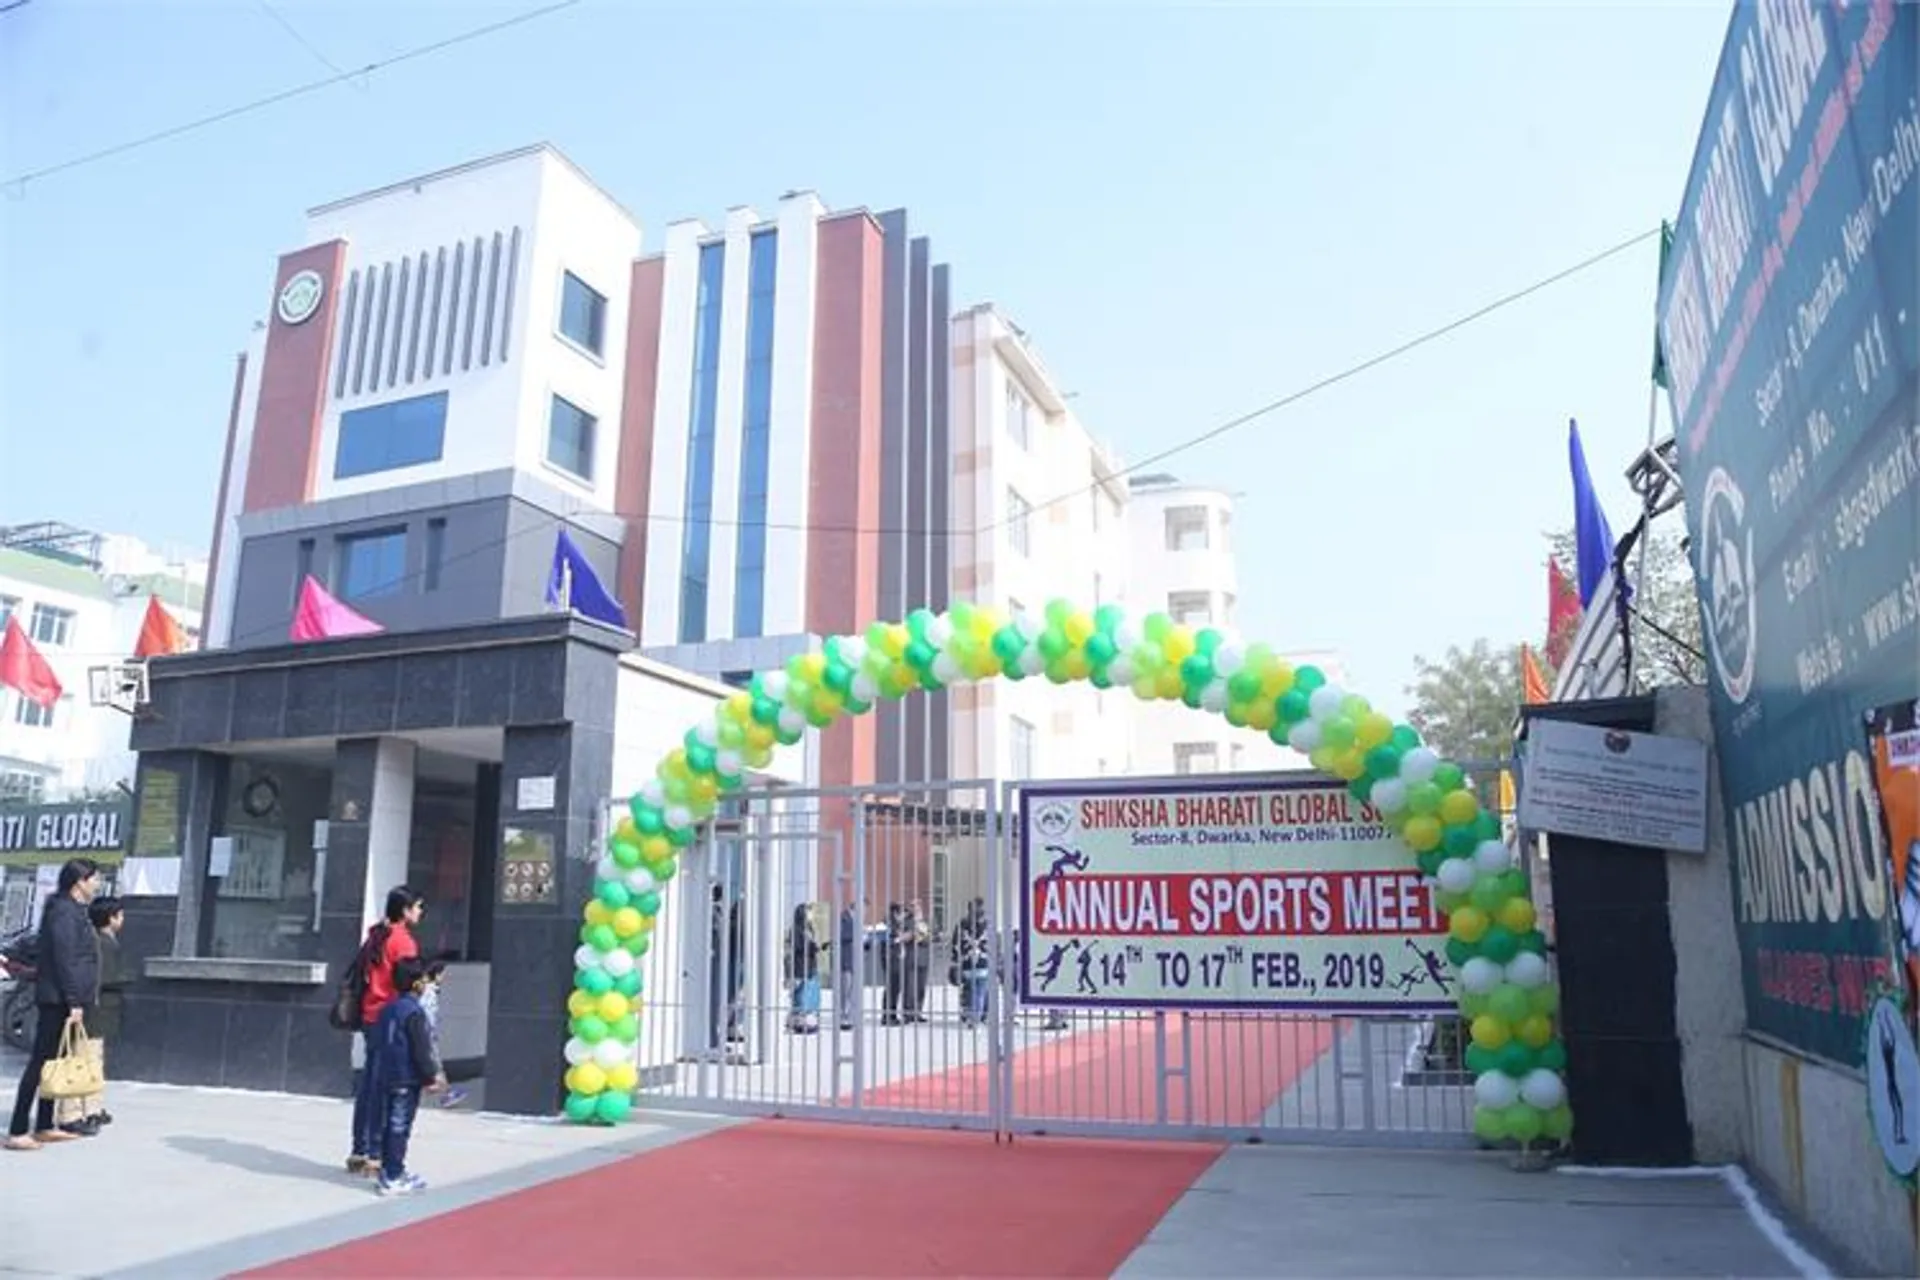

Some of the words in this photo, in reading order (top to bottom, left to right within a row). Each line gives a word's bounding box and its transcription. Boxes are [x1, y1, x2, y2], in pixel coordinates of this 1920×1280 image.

[0, 814, 24, 849] TI
[36, 811, 119, 849] GLOBAL
[1081, 798, 1169, 830] SHIKSHA
[1175, 795, 1263, 827] BHARATI
[1270, 792, 1353, 825] GLOBAL
[1198, 826, 1256, 845] Dwarka,
[1260, 826, 1297, 843] New
[1733, 749, 1891, 923] ADMISSIO
[1041, 879, 1179, 931] ANNUAL
[1189, 876, 1332, 932] SPORTS
[1343, 874, 1438, 930] MEET
[1155, 951, 1190, 988] TO
[1323, 951, 1385, 989] 2019
